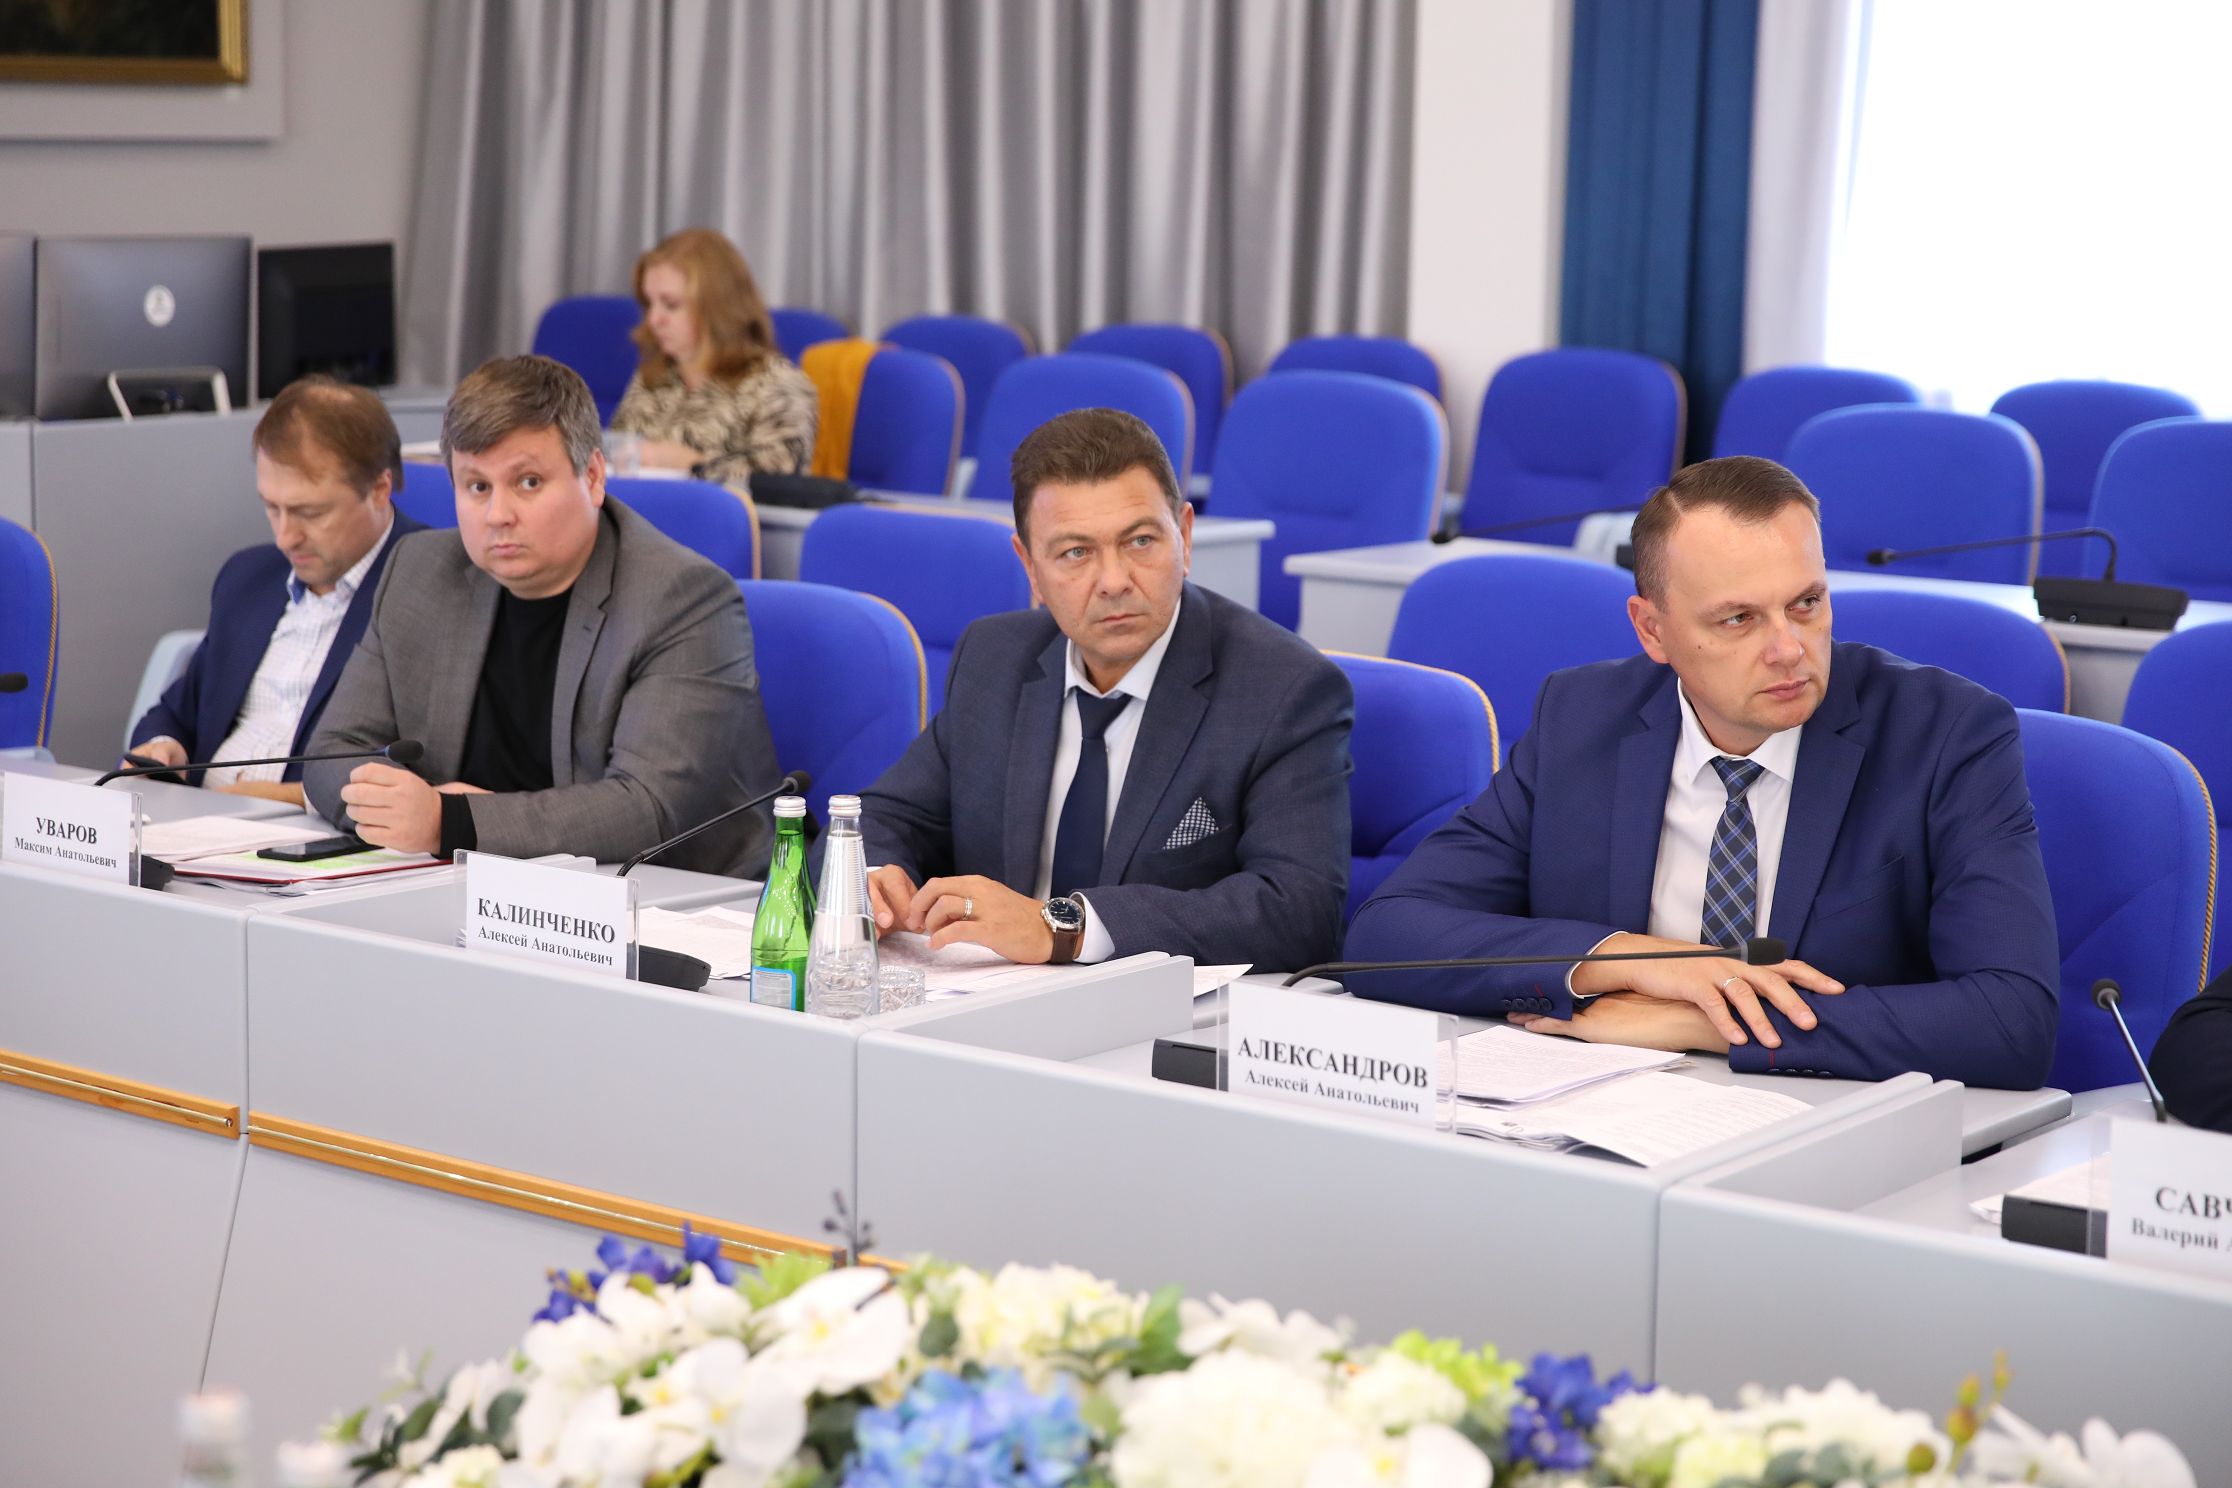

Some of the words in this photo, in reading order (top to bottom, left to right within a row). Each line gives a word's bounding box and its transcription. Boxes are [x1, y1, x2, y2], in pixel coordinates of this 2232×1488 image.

[36, 816, 98, 845] УВАРОВ
[15, 836, 53, 855] Максим
[55, 846, 118, 869] Анатольевич
[477, 897, 616, 944] КАЛИНЧЕНКО
[478, 925, 528, 948] Алексей
[531, 936, 613, 966] Анатольевич
[1237, 1036, 1429, 1089] АЛЕКСАНДРОВ
[1245, 1069, 1309, 1094] Алексей
[1313, 1082, 1420, 1113] Анатольевич
[2131, 1217, 2219, 1250] Валерий
